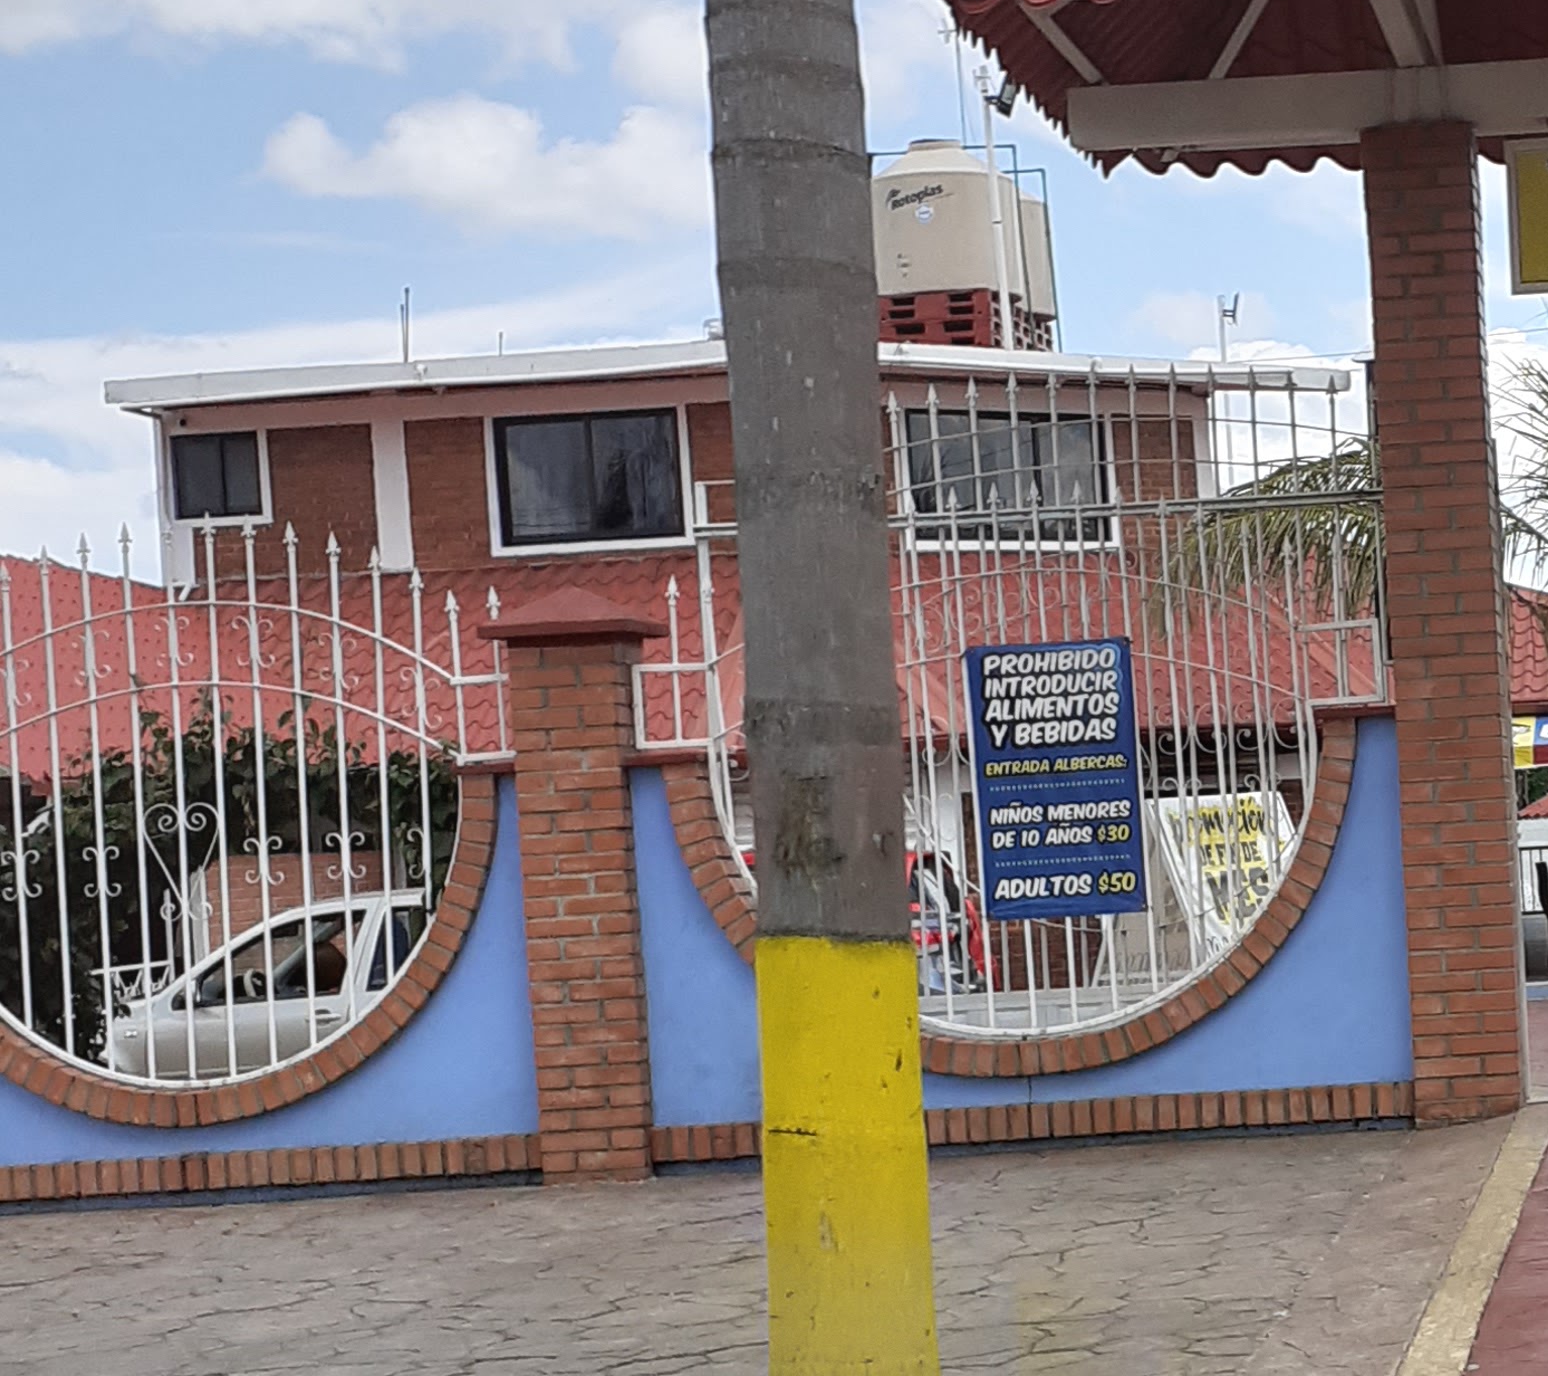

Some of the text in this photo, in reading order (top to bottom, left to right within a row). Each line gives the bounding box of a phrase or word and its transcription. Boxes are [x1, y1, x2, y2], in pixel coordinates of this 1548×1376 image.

[983, 647, 1116, 676] PROHIBIDO
[984, 670, 1118, 699] INTRODUCIR
[985, 693, 1119, 723] ALIMENTOS
[990, 718, 1116, 748] Y BEBIDAS
[985, 754, 1128, 776] ENTRADA ALBERCAS:
[990, 799, 1130, 825] NIÑOS MENORES
[992, 830, 1016, 849] DE
[1045, 823, 1092, 845] AÑOS
[1097, 825, 1130, 843] $30
[994, 872, 1135, 899] ADULTOS $50
